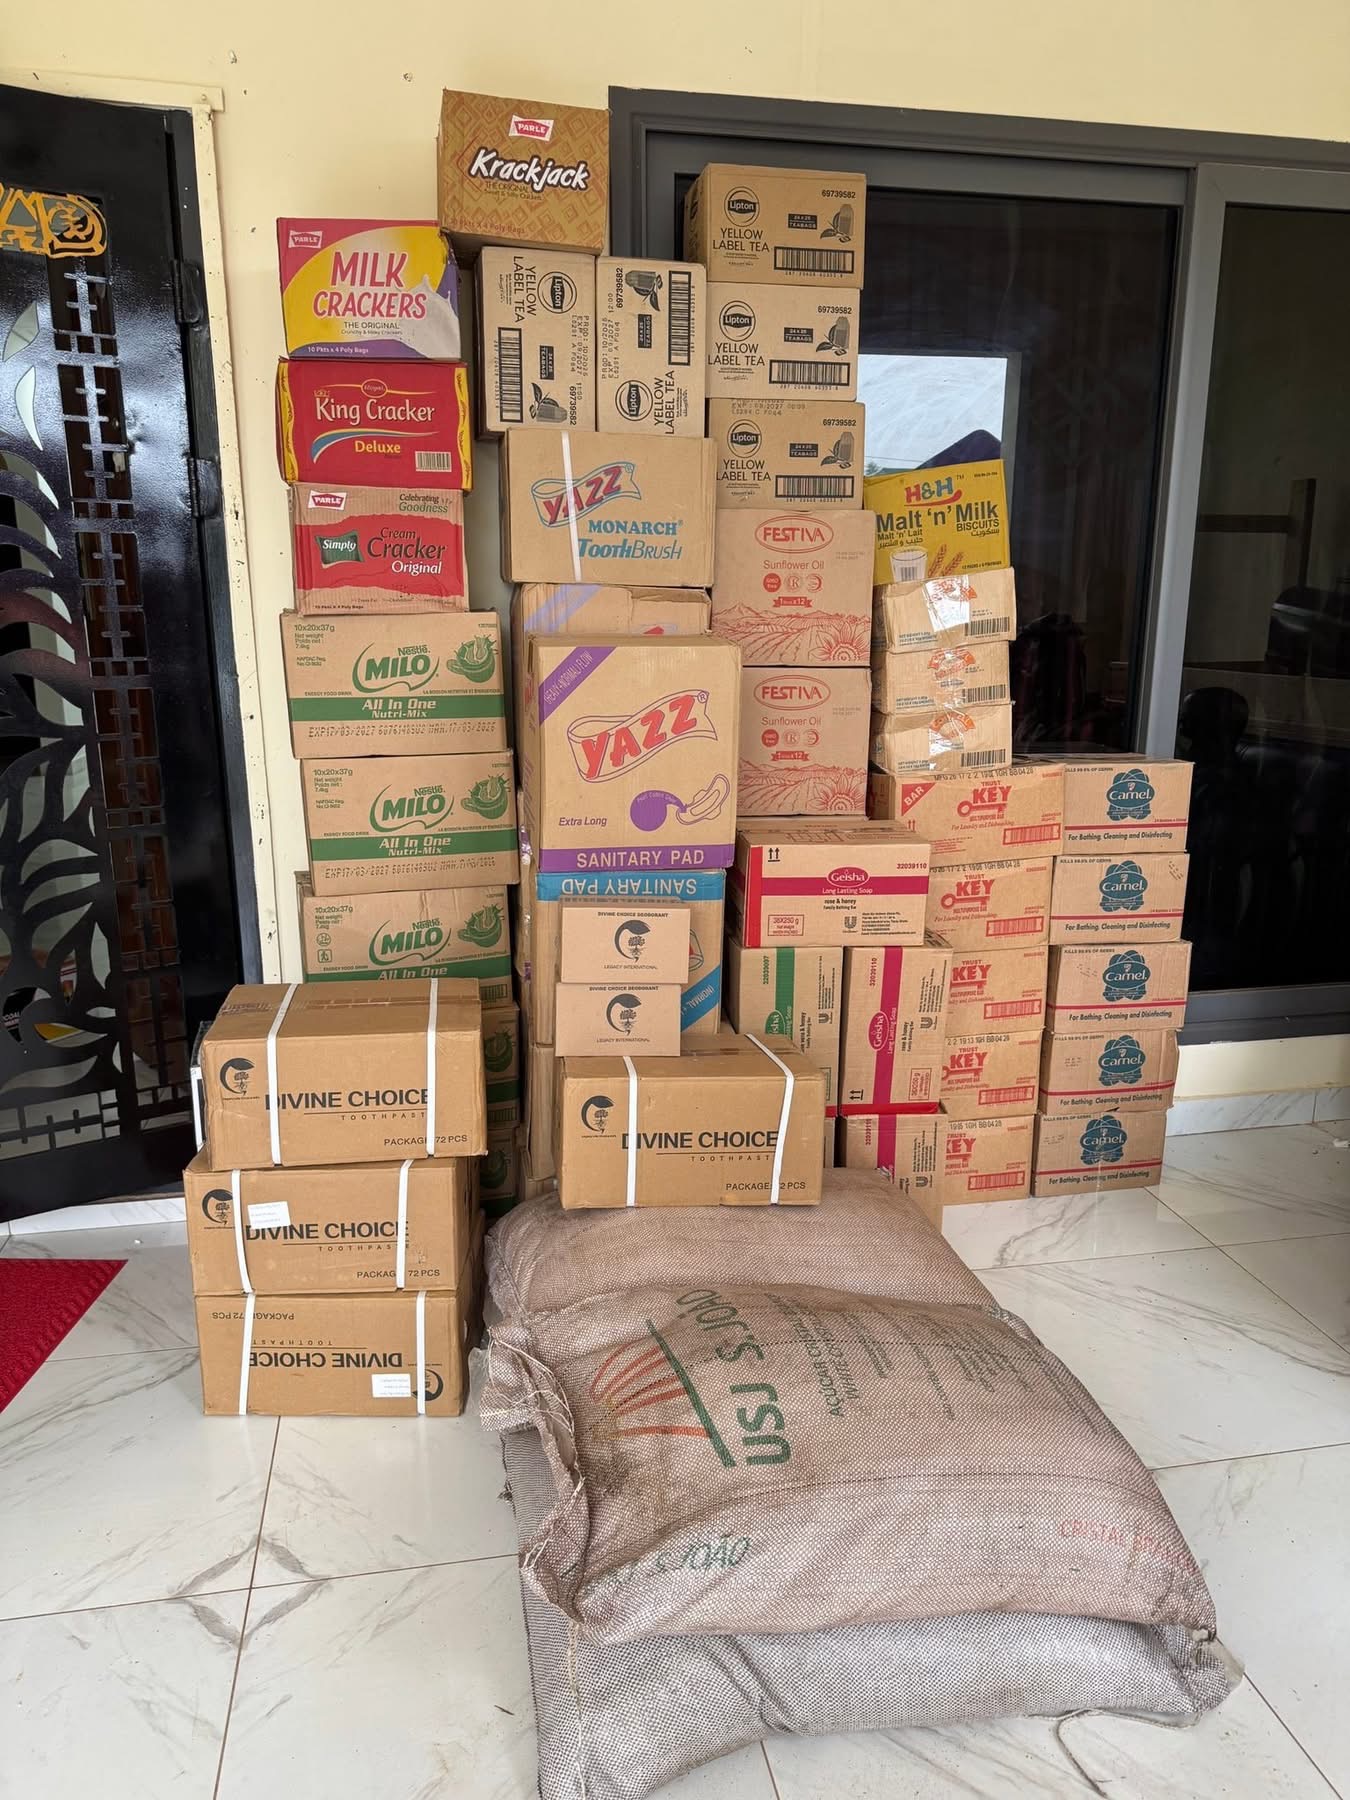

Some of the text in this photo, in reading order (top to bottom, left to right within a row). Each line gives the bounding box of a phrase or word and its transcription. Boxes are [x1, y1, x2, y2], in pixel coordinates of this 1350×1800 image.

[517, 123, 546, 134] PARLE
[469, 148, 590, 191] Krackjack
[730, 200, 754, 210] Lipton
[720, 228, 763, 240] YELLOW
[712, 240, 770, 252] LABEL TEA
[330, 251, 408, 288] MILK
[513, 256, 525, 322] LABEL TEA
[525, 266, 536, 316] YELLOW
[553, 277, 562, 308] Lipton
[313, 291, 427, 319] CRACKERS
[725, 315, 750, 325] Lipton
[715, 342, 759, 354] YELLOW
[708, 355, 765, 366] LABEL TEA
[569, 386, 577, 425] 69739582
[630, 387, 638, 415] Lipton
[654, 377, 664, 426] YELLOW
[665, 370, 675, 434] LABEL TEA
[316, 397, 435, 425] King Cracker
[823, 419, 857, 427] 69739582
[733, 433, 757, 442] Lipton
[355, 440, 400, 454] Deluxe
[724, 460, 765, 469] YELLOW
[716, 471, 771, 481] LABEL TEA
[543, 466, 622, 524] YAZZ
[905, 477, 953, 503] H&H
[314, 496, 341, 505] PARLE
[400, 493, 439, 504] Celebrating
[398, 502, 448, 513] Goodness
[876, 511, 922, 532] Malt
[956, 501, 998, 522] Milk
[589, 520, 678, 535] MONARCH
[956, 519, 999, 532] BISCUITS
[380, 527, 416, 539] Cream
[763, 527, 825, 542] FESTIVA
[878, 529, 923, 541] Malt Lait
[322, 539, 357, 552] Simply
[367, 537, 446, 559] Cracker
[391, 560, 442, 576] Original
[763, 560, 825, 570] Sunflower Oil
[294, 624, 335, 633] 10x20x37g
[365, 654, 431, 681] MILO
[761, 686, 822, 700] FESTIVA
[362, 698, 437, 710] All In One
[371, 710, 428, 719] Nutri-Mix
[761, 717, 822, 726] Sunflower Oil
[581, 694, 698, 780] YAZZ
[904, 786, 925, 806] BAR
[973, 785, 1012, 804] KEY
[1109, 789, 1151, 801] Camel
[382, 794, 446, 821] MILO
[558, 817, 607, 828] Extra Long
[379, 836, 451, 849] All In One
[1103, 832, 1127, 840] Cleaning
[388, 847, 443, 857] Nutri-Mix
[576, 850, 704, 868] SANITARY PAD
[830, 871, 865, 883] Geisha
[561, 879, 696, 895] SANITARY PAD
[956, 879, 995, 896] KEY
[1102, 880, 1145, 891] Camel
[315, 906, 353, 914] 10x20x37g
[1101, 923, 1126, 931] Cleaning
[381, 927, 444, 955] MILO
[378, 967, 448, 980] All In One
[952, 965, 992, 981] KEY
[1105, 970, 1147, 982] Camel
[1104, 1012, 1129, 1020] Cleaning
[873, 1015, 884, 1048] Geisha
[950, 1052, 988, 1069] KEY
[1101, 1056, 1142, 1067] Camel
[1095, 1096, 1119, 1105] Cleaning
[1132, 1094, 1163, 1102] Disinfecting
[448, 1135, 468, 1144] PCS
[699, 1131, 779, 1148] CHOICE
[1082, 1134, 1124, 1146] Camel
[787, 1181, 806, 1190] PCS
[421, 1269, 440, 1277] PCS
[332, 1353, 402, 1367] DIVINE
[730, 1382, 791, 1466] USJ
